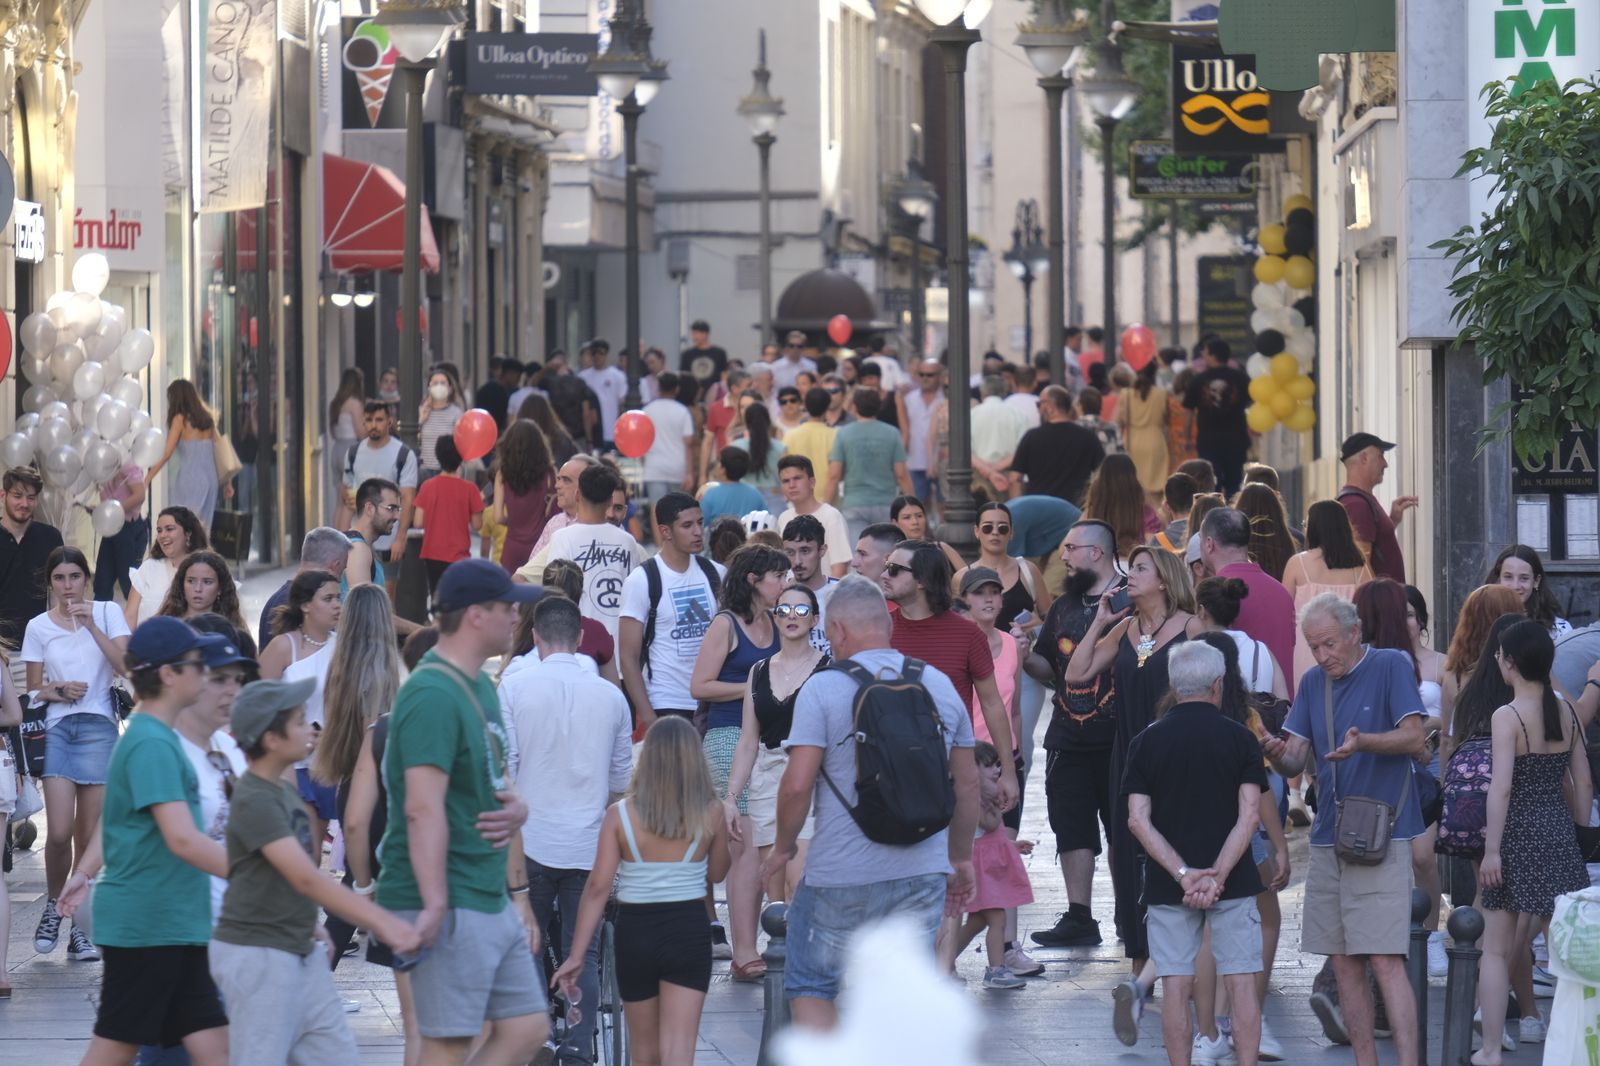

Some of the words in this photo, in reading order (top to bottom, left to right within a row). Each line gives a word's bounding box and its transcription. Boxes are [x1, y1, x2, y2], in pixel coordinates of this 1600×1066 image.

[212, 2, 238, 83] CANO
[478, 45, 525, 63] Ulloa
[1181, 58, 1267, 93] Ullo
[208, 94, 234, 198] MATILDE
[19, 720, 46, 734] PPIN
